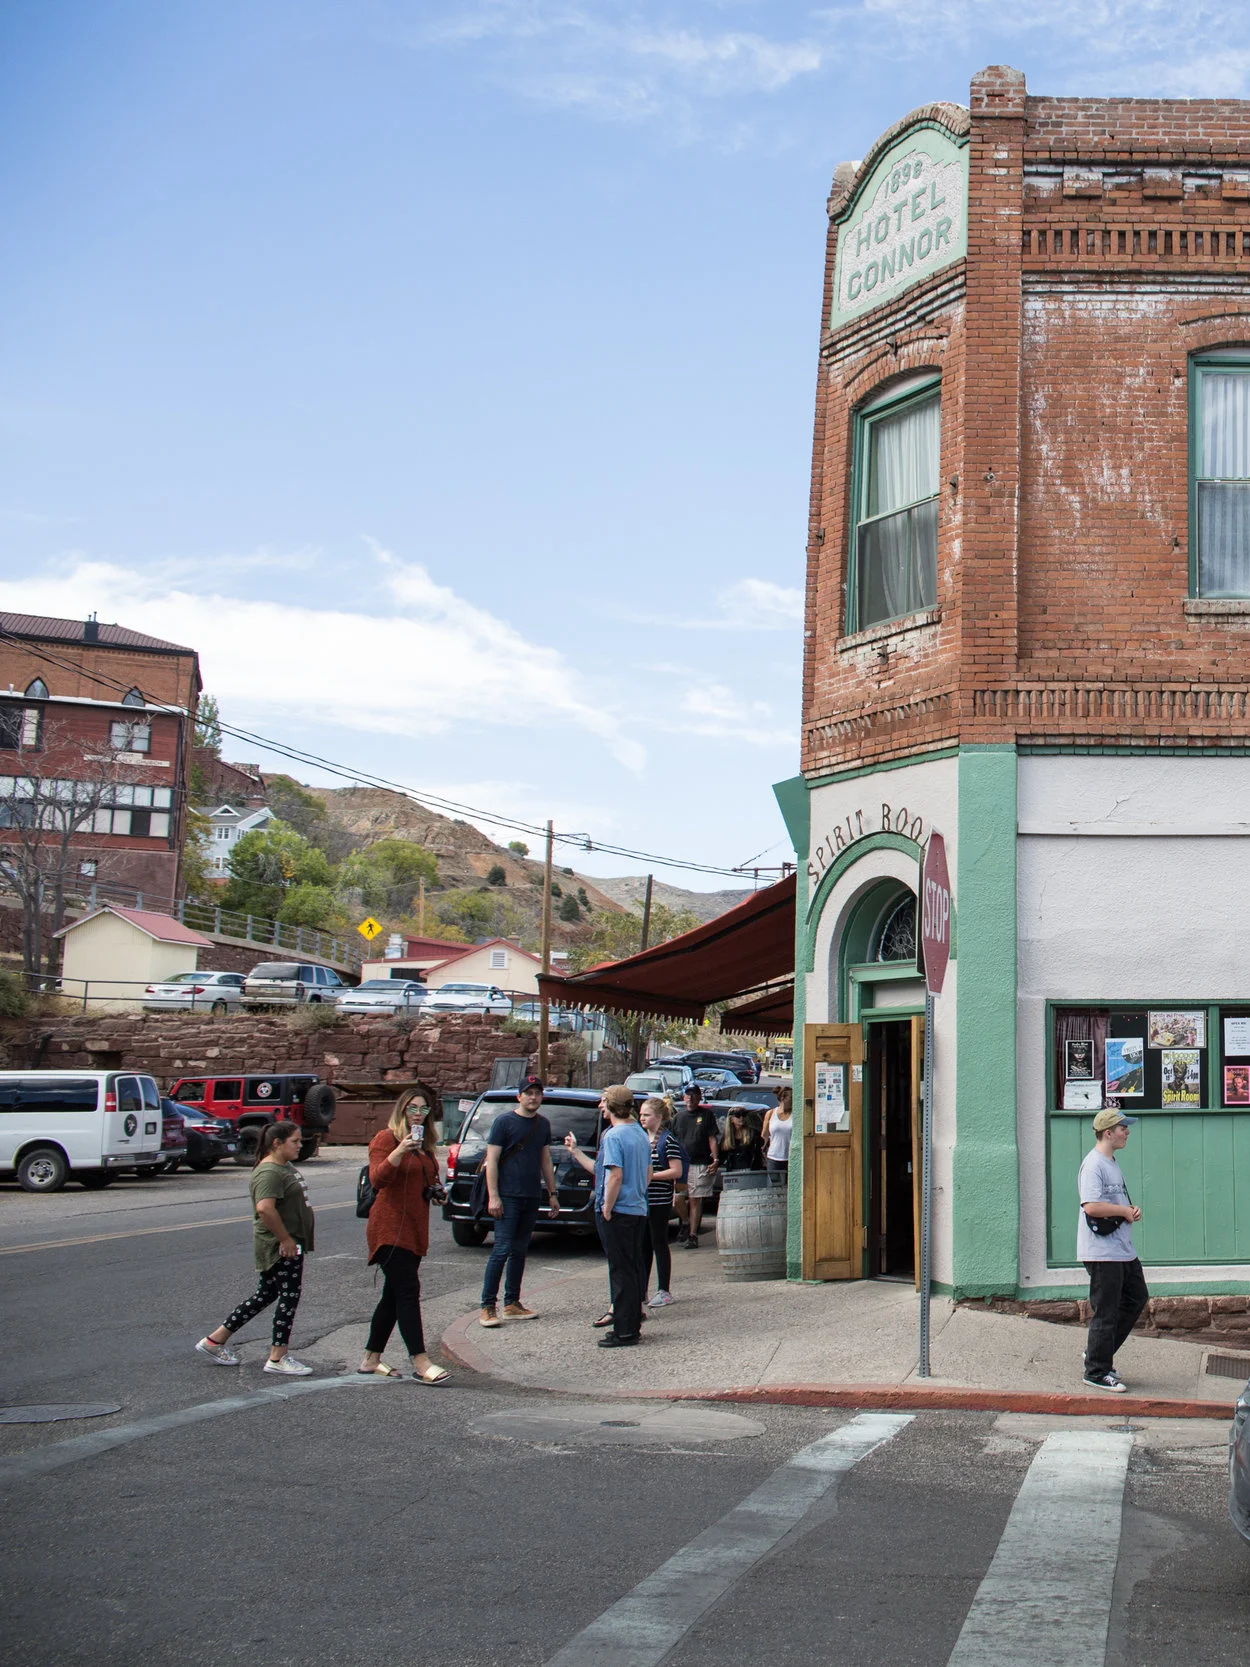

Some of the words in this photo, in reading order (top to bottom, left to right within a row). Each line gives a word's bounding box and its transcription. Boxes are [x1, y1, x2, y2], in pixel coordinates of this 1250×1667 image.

[884, 160, 922, 198] 1898
[855, 180, 945, 257] HOTEL
[847, 215, 952, 300] CONNOR
[807, 809, 864, 886] SPIRIT
[881, 803, 930, 849] ROO
[924, 878, 949, 944] STOP
[1163, 1091, 1181, 1104] Spirit
[1181, 1089, 1200, 1103] Room
